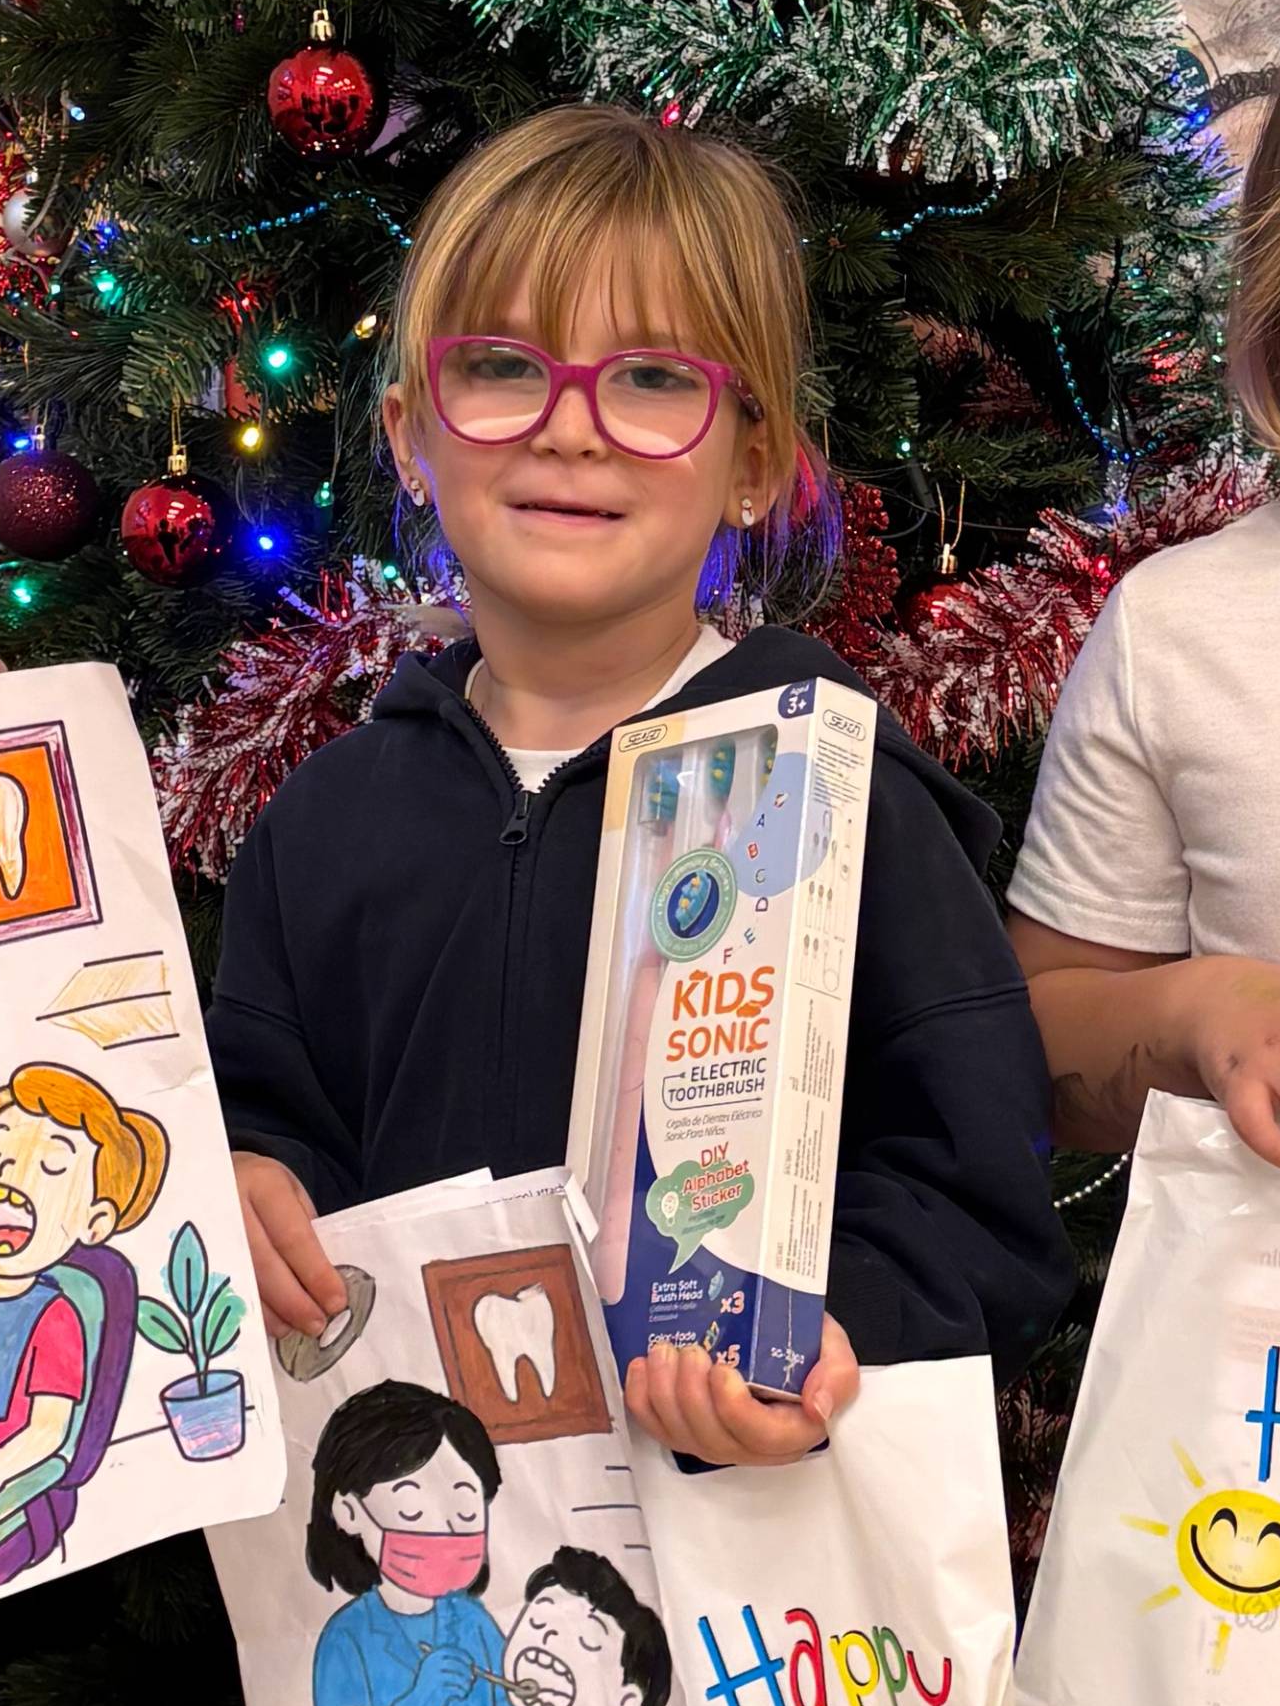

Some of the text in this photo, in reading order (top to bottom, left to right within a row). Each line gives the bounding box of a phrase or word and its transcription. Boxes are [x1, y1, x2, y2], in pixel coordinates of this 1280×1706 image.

[787, 696, 807, 714] 3+
[755, 897, 769, 912] D
[744, 927, 756, 944] E
[723, 947, 733, 964] F
[672, 966, 776, 1021] KIDS
[666, 1018, 770, 1062] SONIC
[691, 1057, 767, 1082] ELECTRIC
[668, 1078, 765, 1102] TOOTHBRUSH
[701, 1141, 729, 1168] DIY
[683, 1159, 749, 1194] Alphabet
[692, 1184, 742, 1211] Sticker
[651, 1289, 703, 1303] Brush Head
[652, 1279, 697, 1292] Extra Soft
[721, 1291, 745, 1315] x3
[716, 1344, 741, 1369] x5
